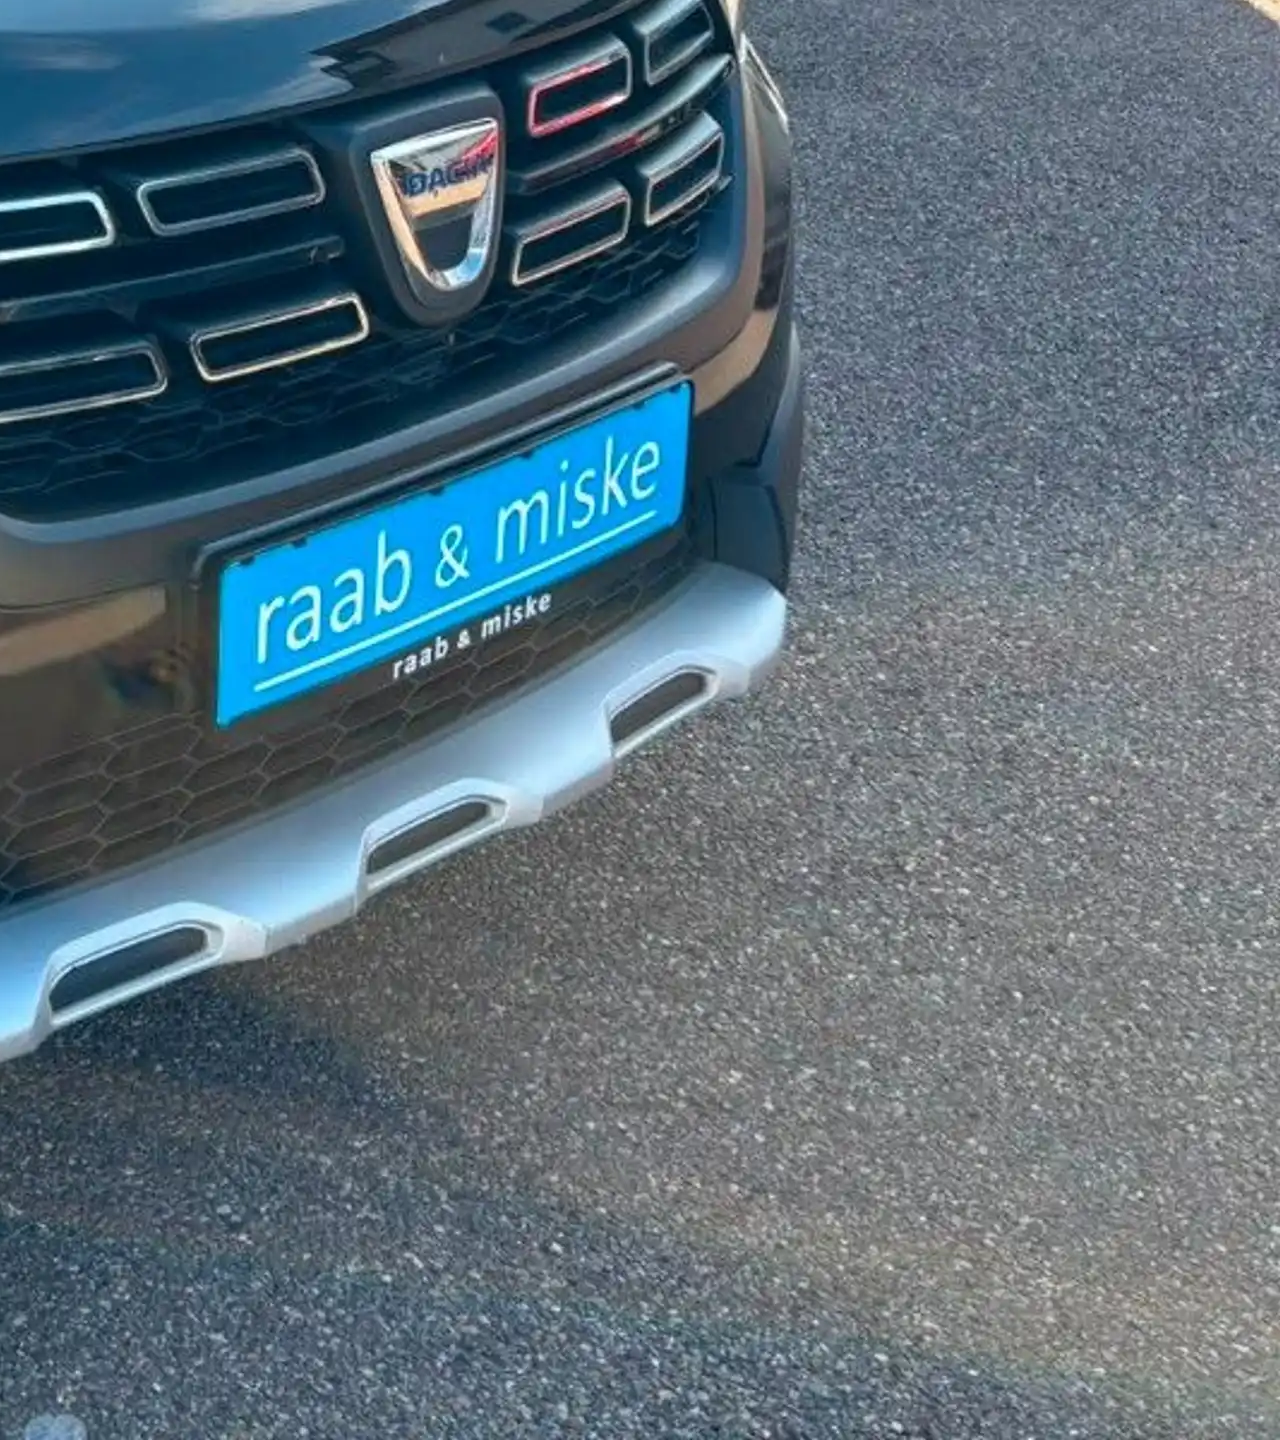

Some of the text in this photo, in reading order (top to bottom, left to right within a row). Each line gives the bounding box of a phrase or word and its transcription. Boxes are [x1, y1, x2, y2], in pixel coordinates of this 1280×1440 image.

[255, 435, 662, 664] raab & miske
[392, 591, 553, 679] raab & miske
